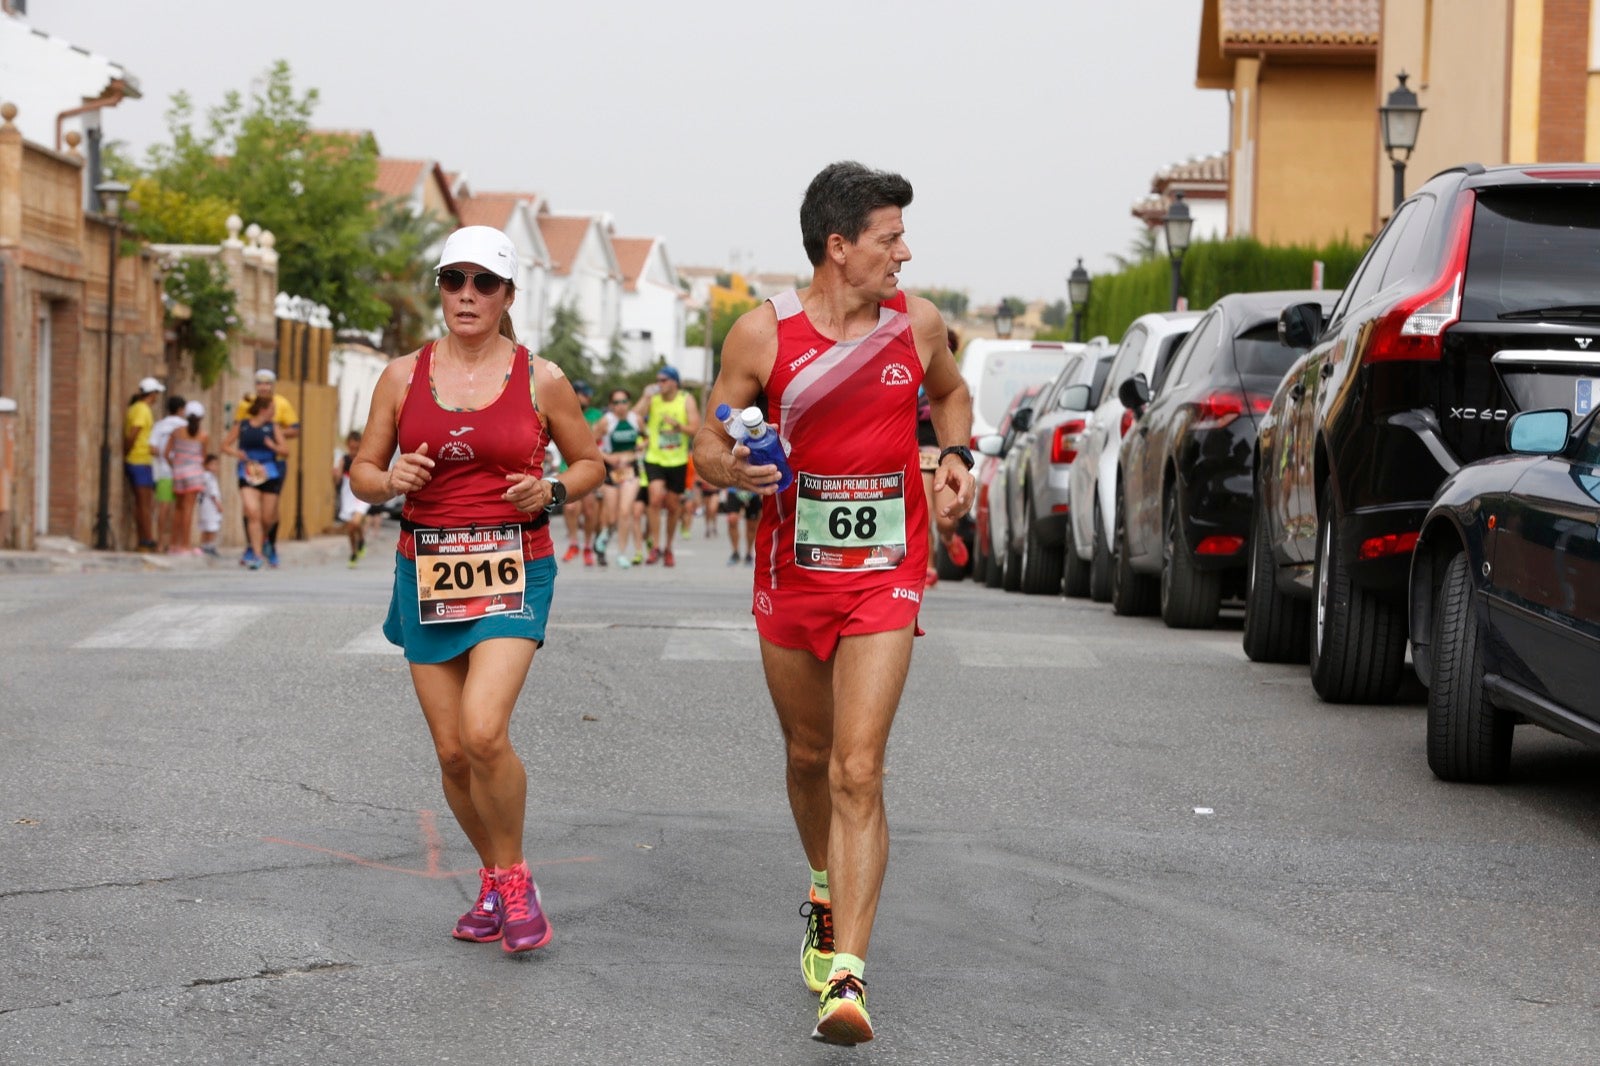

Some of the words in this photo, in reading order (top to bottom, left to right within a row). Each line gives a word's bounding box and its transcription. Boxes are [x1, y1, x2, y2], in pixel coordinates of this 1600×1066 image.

[789, 347, 818, 371] Joma
[804, 478, 822, 490] XXXII
[822, 479, 842, 491] GRAN
[843, 479, 869, 490] PREMIO
[870, 479, 879, 489] DE
[879, 476, 899, 488] FONDO
[821, 491, 850, 500] DIPUTACIÓN
[854, 490, 884, 499] CRUZCAMPO
[828, 506, 877, 540] 68
[421, 533, 439, 545] XXXII
[457, 532, 482, 543] PREMIO
[483, 530, 492, 542] DE
[432, 557, 519, 591] 2016
